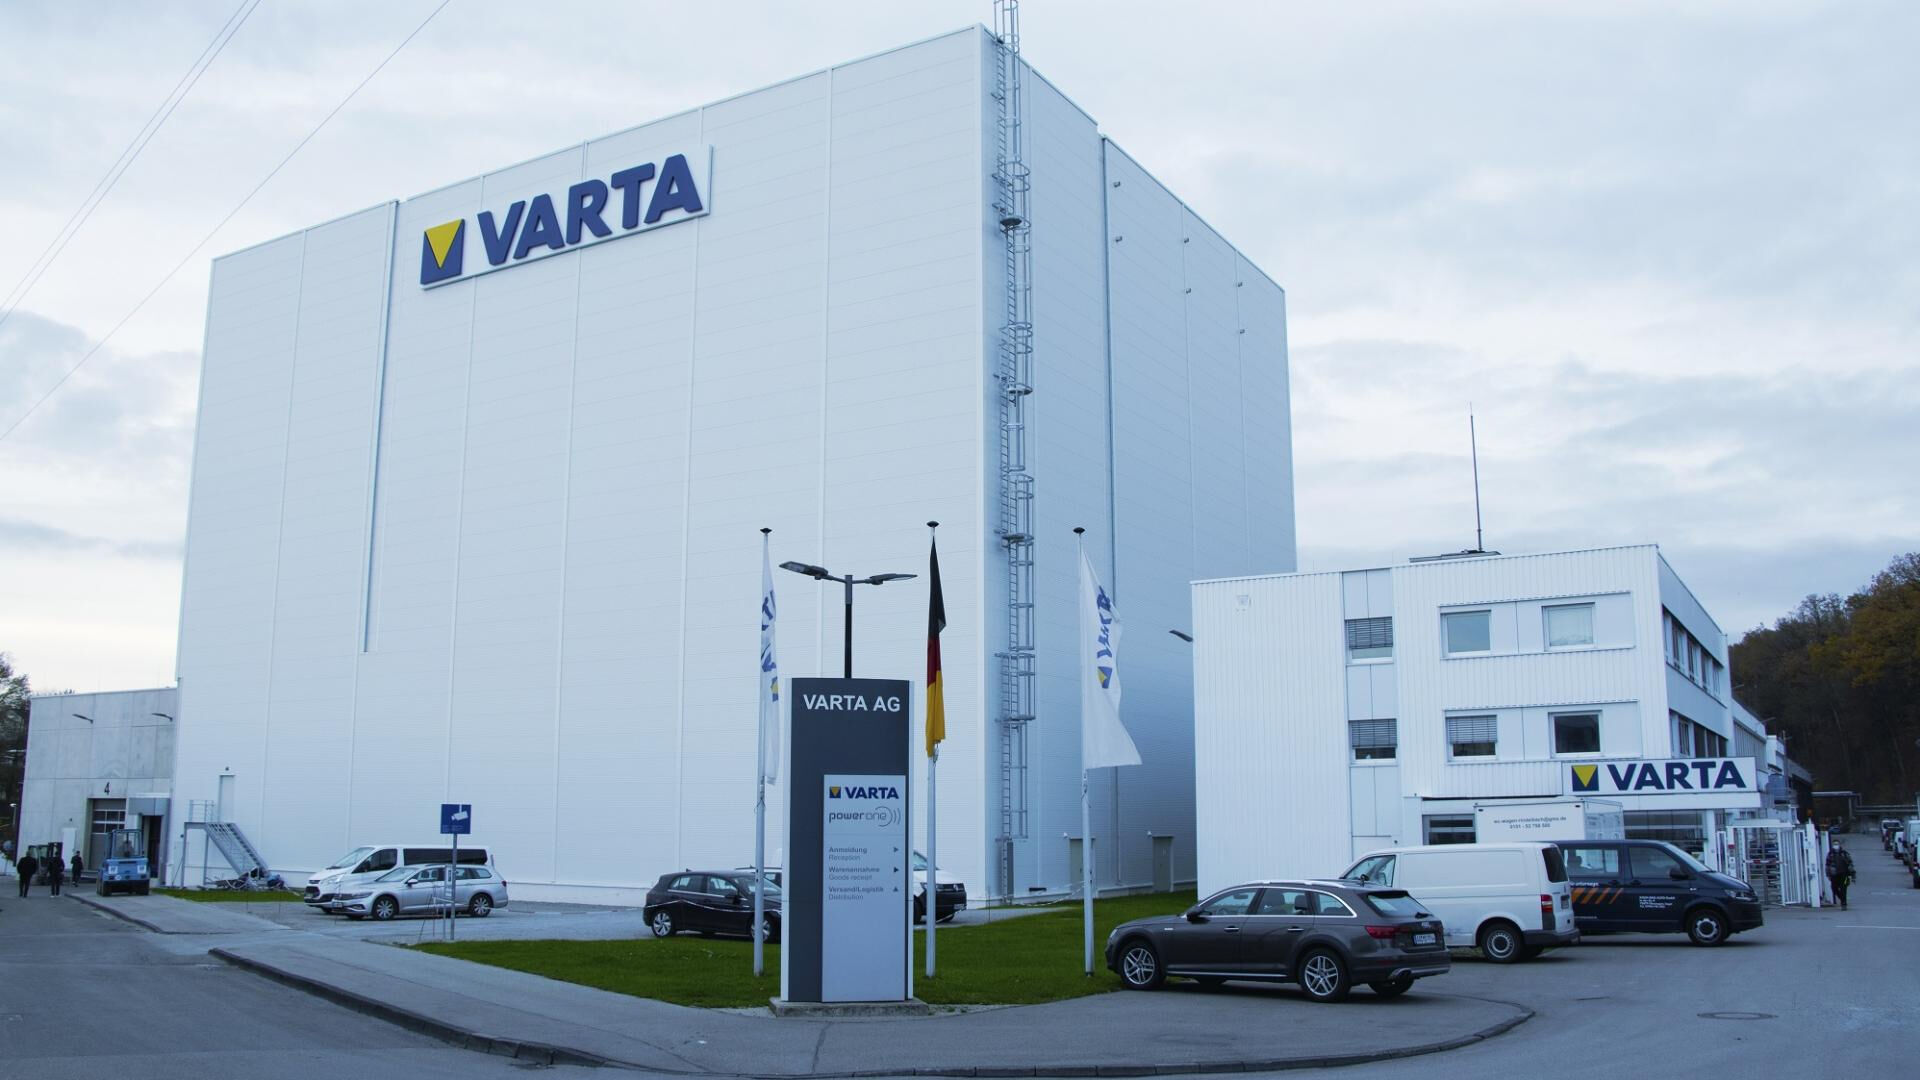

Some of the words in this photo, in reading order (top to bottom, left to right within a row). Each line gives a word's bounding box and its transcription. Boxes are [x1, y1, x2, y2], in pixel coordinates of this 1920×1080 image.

[477, 153, 703, 266] VARTA
[803, 694, 868, 711] VARTA
[873, 696, 901, 712] AG
[1607, 761, 1747, 791] VARTA
[104, 781, 110, 795] 4
[845, 786, 899, 799] VARTA
